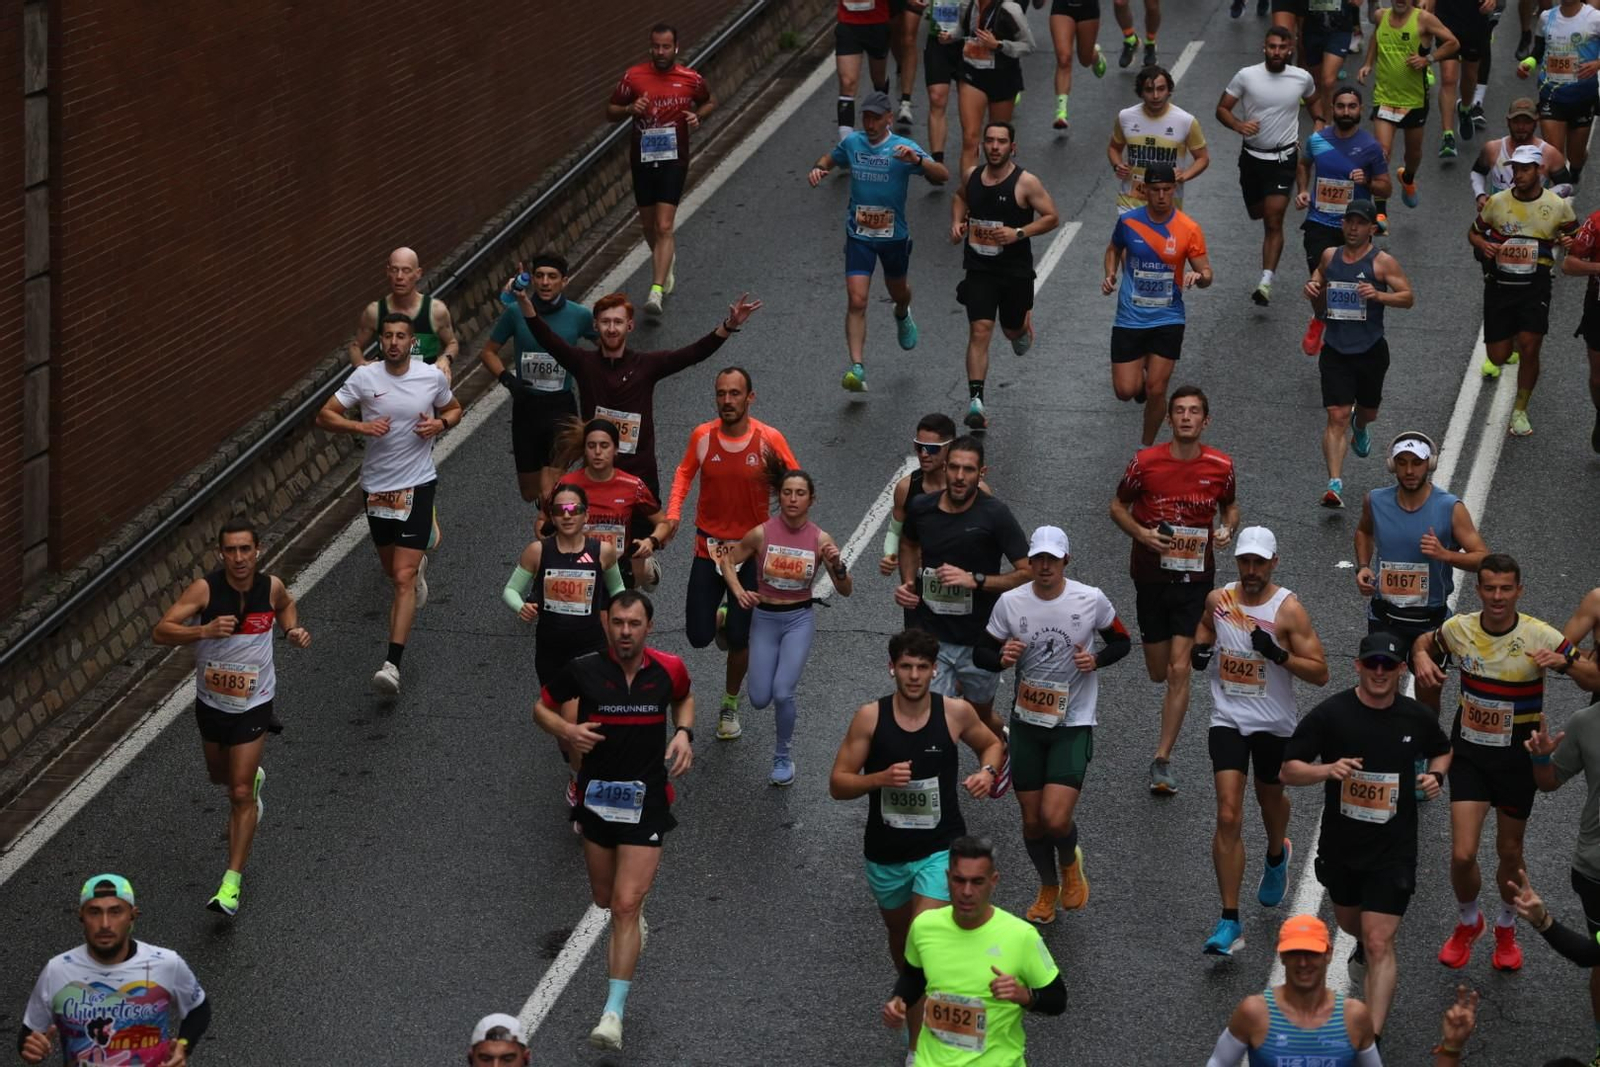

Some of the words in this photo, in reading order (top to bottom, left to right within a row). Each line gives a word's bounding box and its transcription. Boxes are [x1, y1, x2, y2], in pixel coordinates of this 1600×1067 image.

[1321, 187, 1345, 199] 4127
[861, 211, 885, 226] 3797
[1502, 246, 1528, 259] 4230
[1138, 280, 1164, 292] 2323
[1331, 290, 1358, 303] 2390
[526, 361, 561, 375] 17684
[1170, 538, 1198, 552] 5048
[771, 557, 803, 574] 4446
[551, 581, 583, 595] 4301
[1386, 573, 1416, 588] 6167
[1223, 659, 1254, 677] 4242
[212, 673, 246, 690] 5183
[1022, 689, 1055, 706] 4420
[597, 703, 659, 713] PRORUNNERS
[1468, 707, 1500, 726] 5020
[594, 785, 632, 802] 2195
[1350, 782, 1385, 801] 6261
[890, 792, 927, 807] 9389
[932, 1004, 971, 1027] 6152
